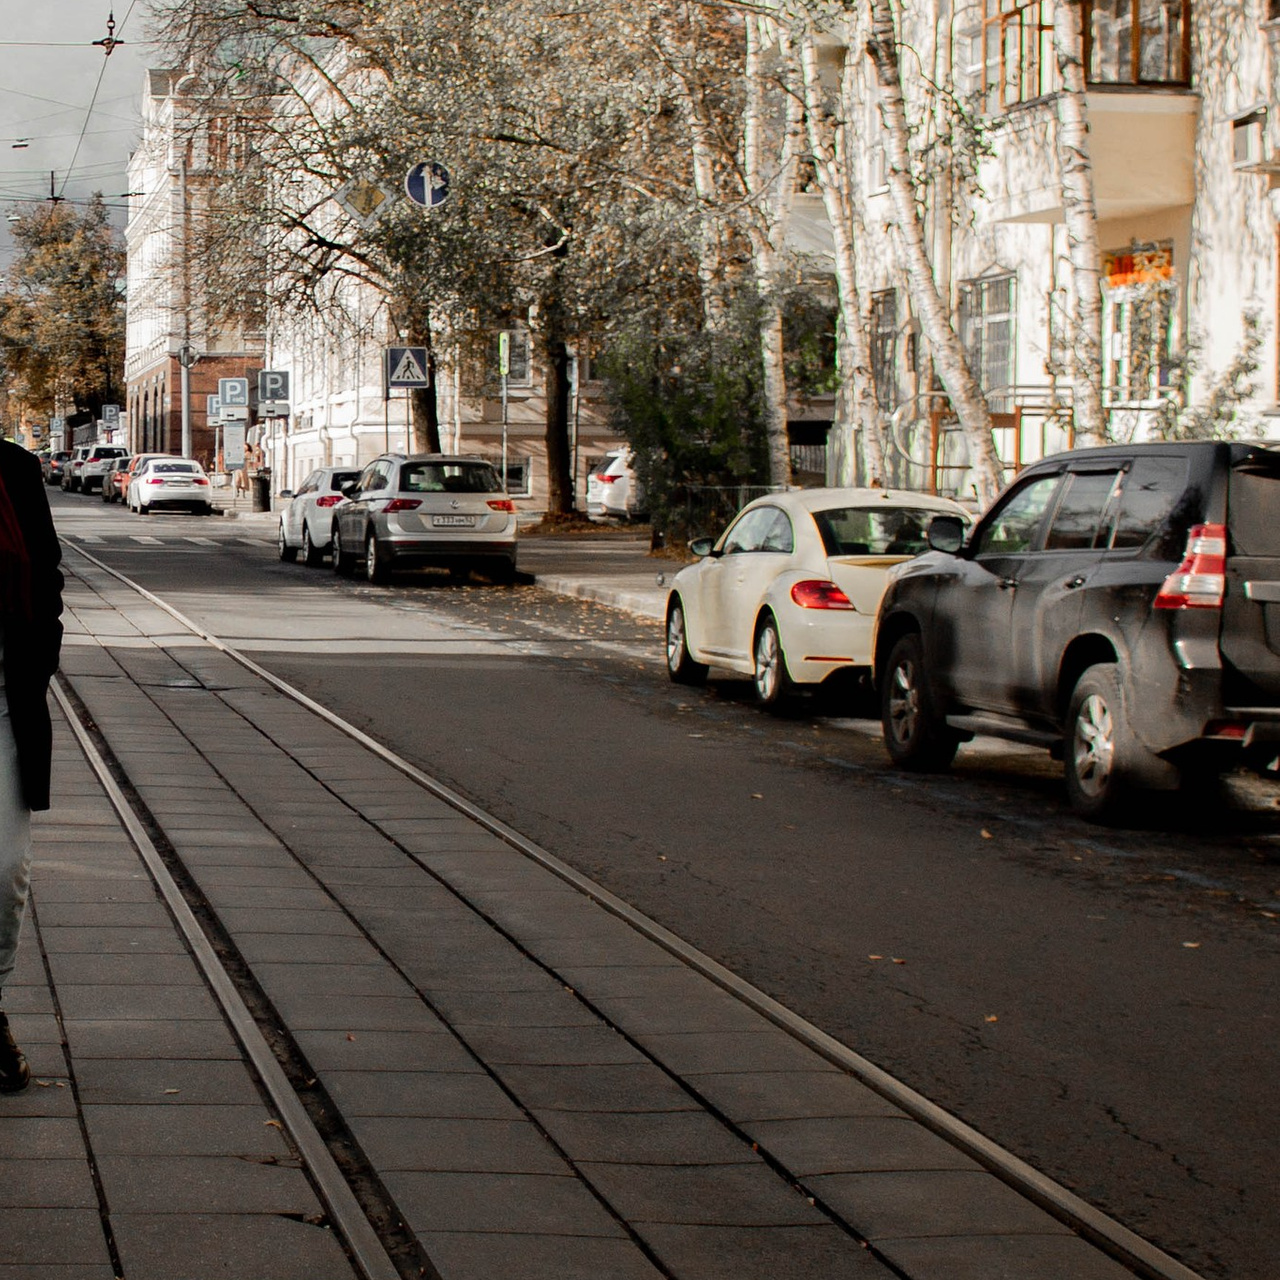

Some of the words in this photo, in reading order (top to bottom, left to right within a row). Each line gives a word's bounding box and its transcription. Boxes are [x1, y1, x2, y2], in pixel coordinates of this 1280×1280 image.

[226, 382, 241, 403] P
[266, 374, 283, 397] P
[106, 407, 116, 420] P
